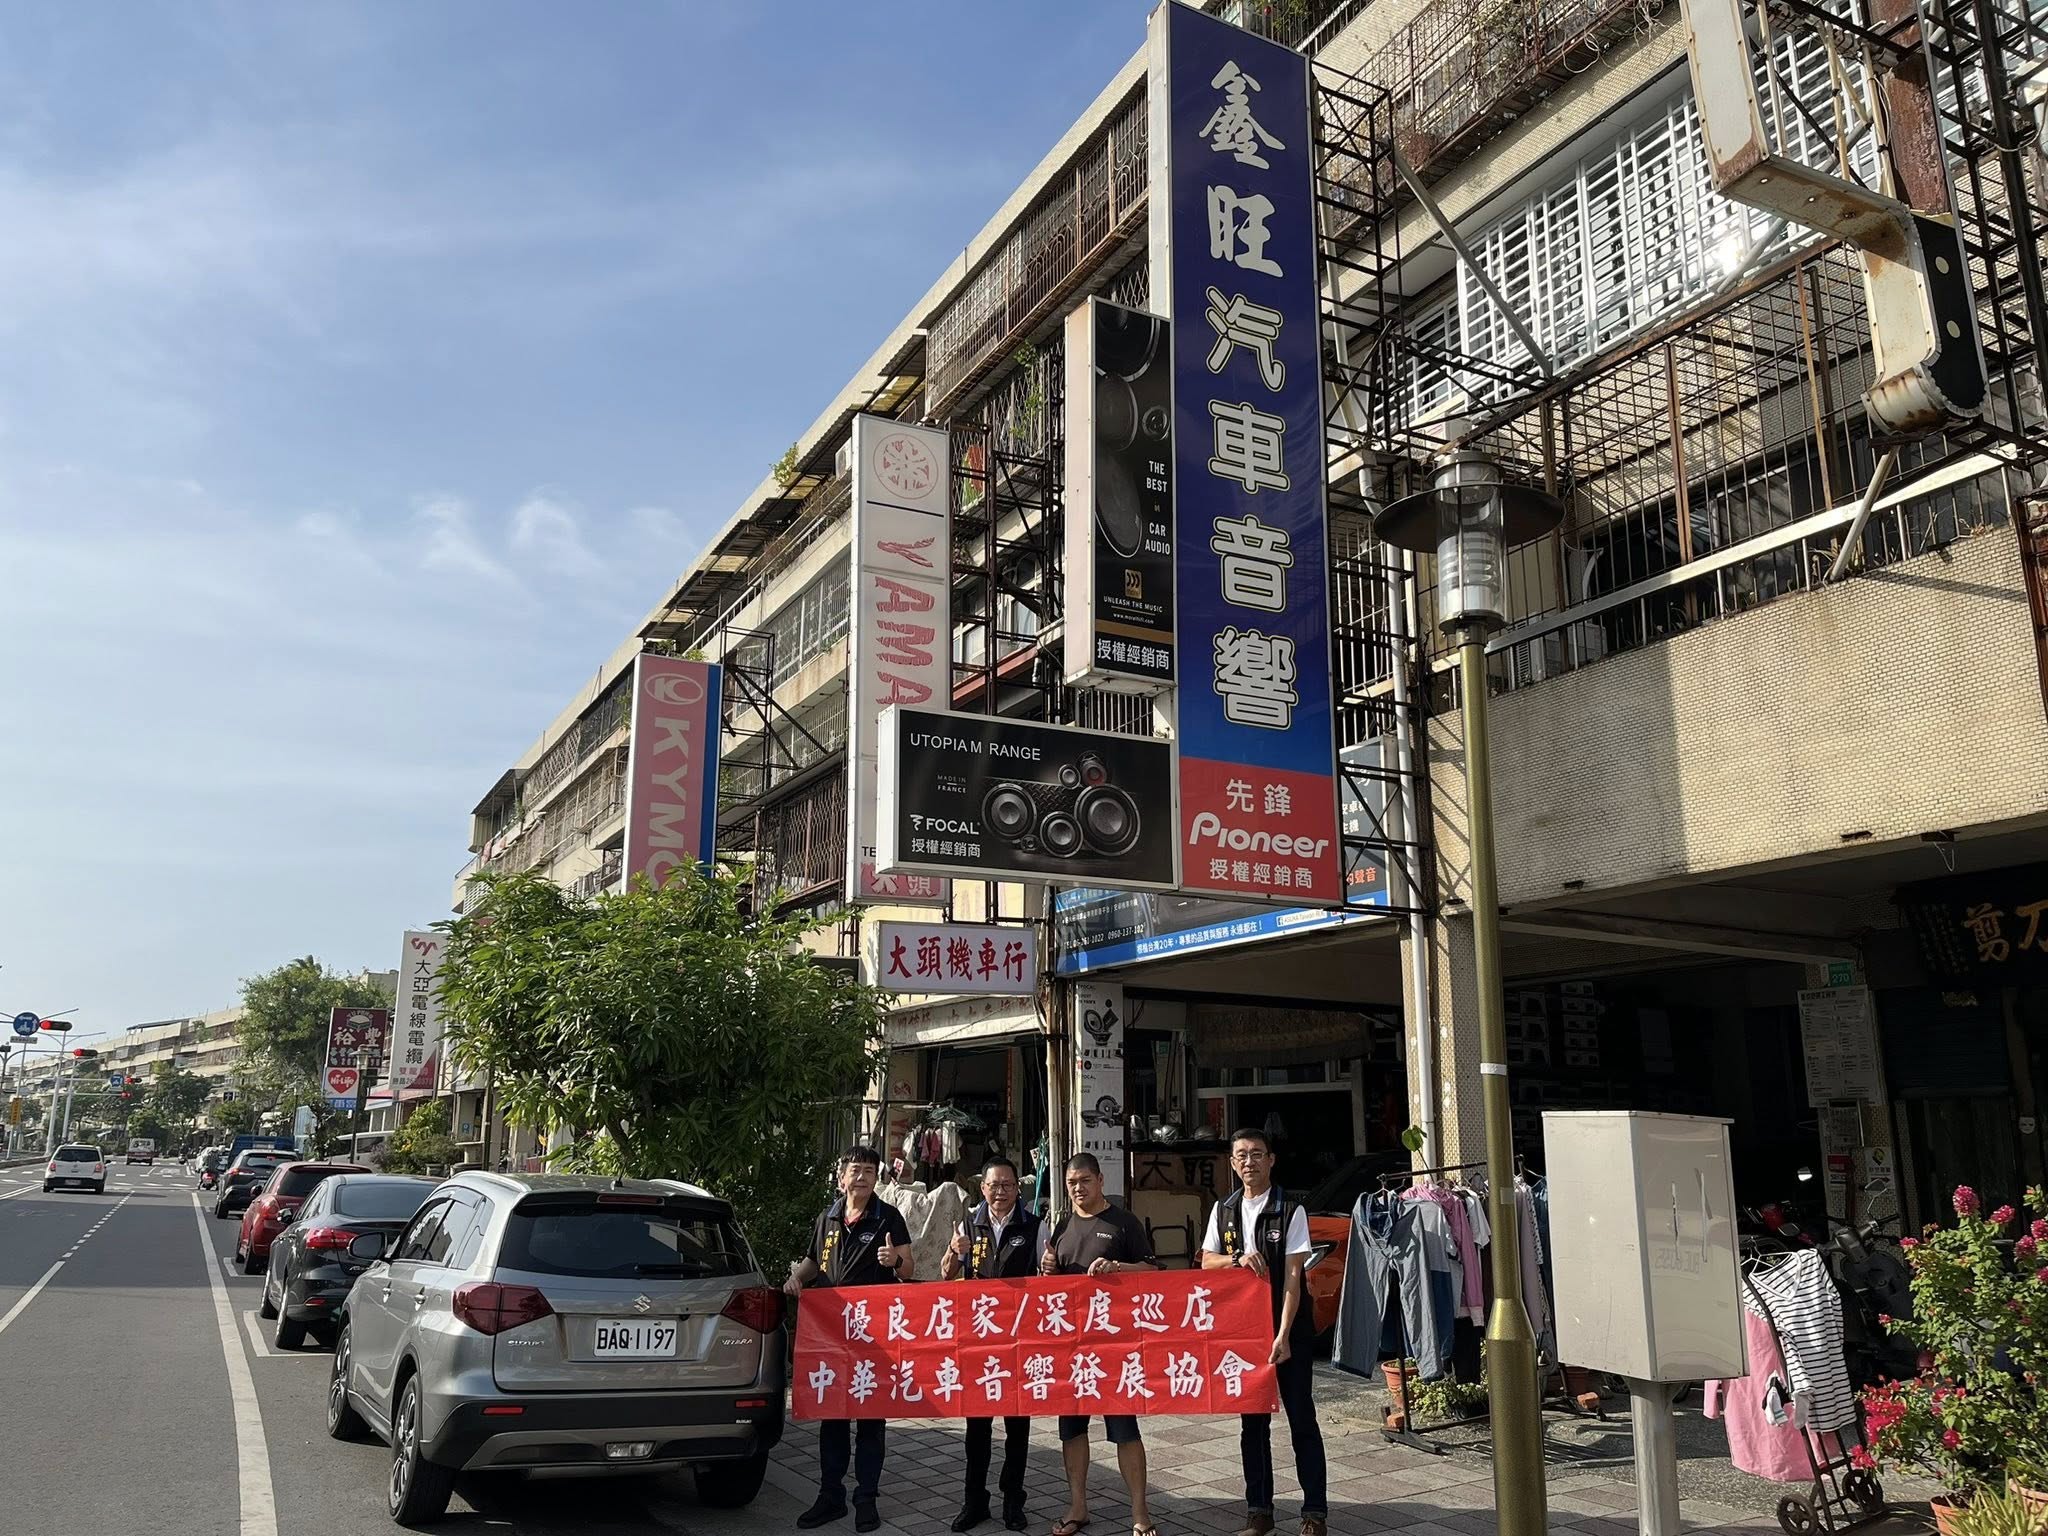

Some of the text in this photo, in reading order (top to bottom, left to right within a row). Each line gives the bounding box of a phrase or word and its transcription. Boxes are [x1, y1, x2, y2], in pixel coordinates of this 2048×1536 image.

[1198, 60, 1298, 730] 鑫旺汽車音響
[1149, 460, 1165, 475] THE
[1146, 477, 1167, 493] BEST
[1149, 522, 1166, 537] CAR
[1145, 539, 1170, 555] AUDIO
[1103, 595, 1163, 613] UNLEASH THE MUSIC
[875, 536, 935, 705] YAMA
[1097, 638, 1170, 670] 授權經銷商
[910, 733, 967, 752] UTOPIA
[989, 743, 1041, 761] RANGE
[937, 774, 957, 783] MADE
[937, 784, 967, 794] FRANCE
[645, 716, 690, 892] KYMC
[1226, 778, 1291, 816] 先鋒
[926, 817, 980, 835] FOCAL
[1189, 812, 1329, 859] Pioneer
[911, 837, 981, 858] 授權經銷商
[1209, 858, 1312, 889] 授權經銷商
[888, 935, 1027, 983] 大頭機車行
[406, 959, 431, 1065] 大亞電線電纜
[1140, 1153, 1218, 1200] 大頭
[841, 1285, 1215, 1344] 優良店家/深度巡店
[808, 1349, 1257, 1405] 中華汽車音響發展協會
